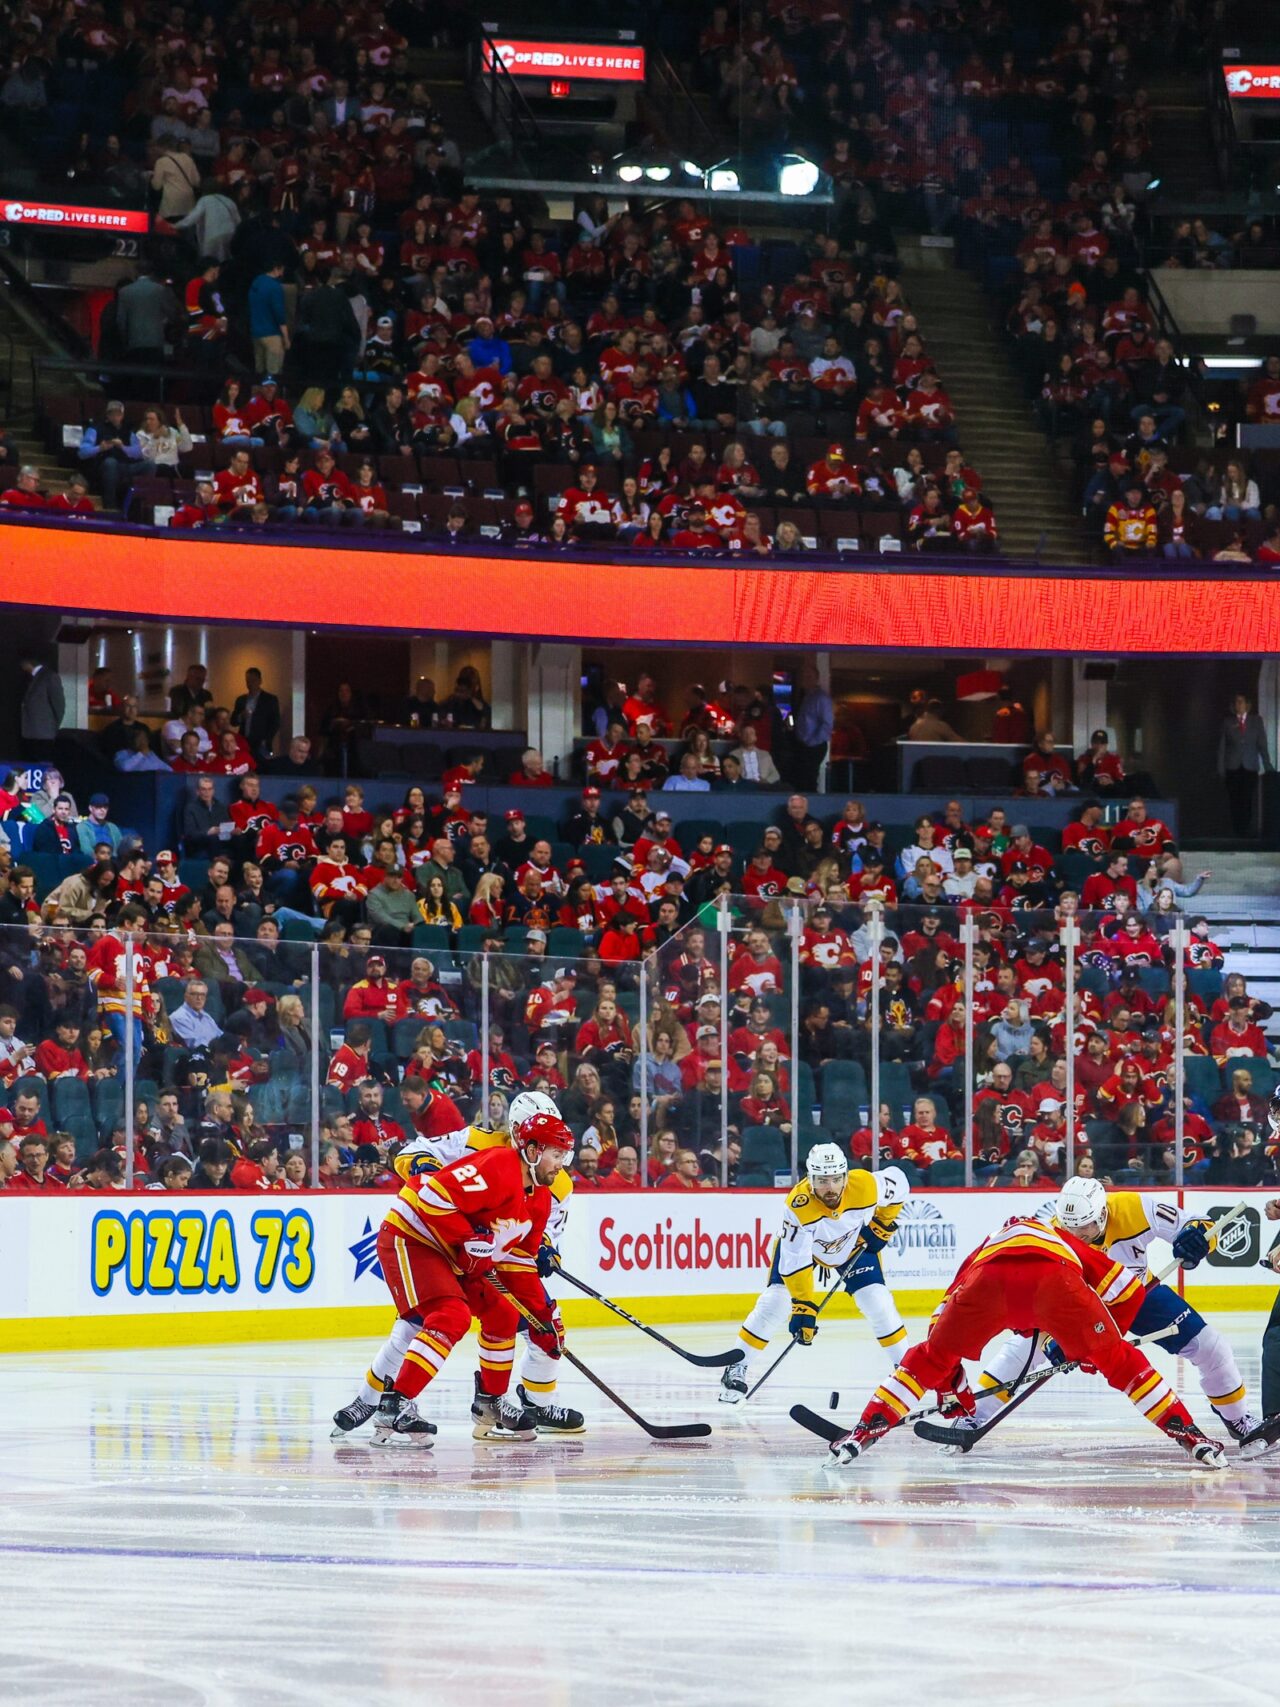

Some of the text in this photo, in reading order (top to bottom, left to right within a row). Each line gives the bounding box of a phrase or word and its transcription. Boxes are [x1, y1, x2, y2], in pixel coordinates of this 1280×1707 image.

[515, 52, 532, 63] OF
[531, 52, 565, 66] RED
[564, 57, 604, 68] LIVES
[605, 59, 641, 70] HERE
[1252, 77, 1270, 87] OF
[23, 209, 38, 218] OF
[37, 208, 64, 222] RED
[64, 213, 97, 223] LIVES
[98, 215, 128, 226] HERE
[114, 238, 138, 257] 22
[26, 769, 43, 790] 18
[333, 1062, 348, 1077] 19
[1077, 1131, 1088, 1143] 8
[823, 1153, 835, 1161] 57
[451, 1164, 489, 1193] 27
[884, 1176, 897, 1200] 57
[1155, 1203, 1178, 1225] 10
[782, 1220, 799, 1242] 57
[873, 1226, 892, 1239] CC
[1222, 1228, 1245, 1249] NHL
[598, 1217, 772, 1272] Scotiabank
[887, 1224, 957, 1257] ayman
[91, 1208, 315, 1297] PIZZA 73
[928, 1248, 957, 1260] BUILT
[1131, 1244, 1145, 1259] A
[847, 1265, 876, 1279] CCM
[883, 1265, 920, 1278] erformance
[1006, 1363, 1068, 1391] JTSPEED
